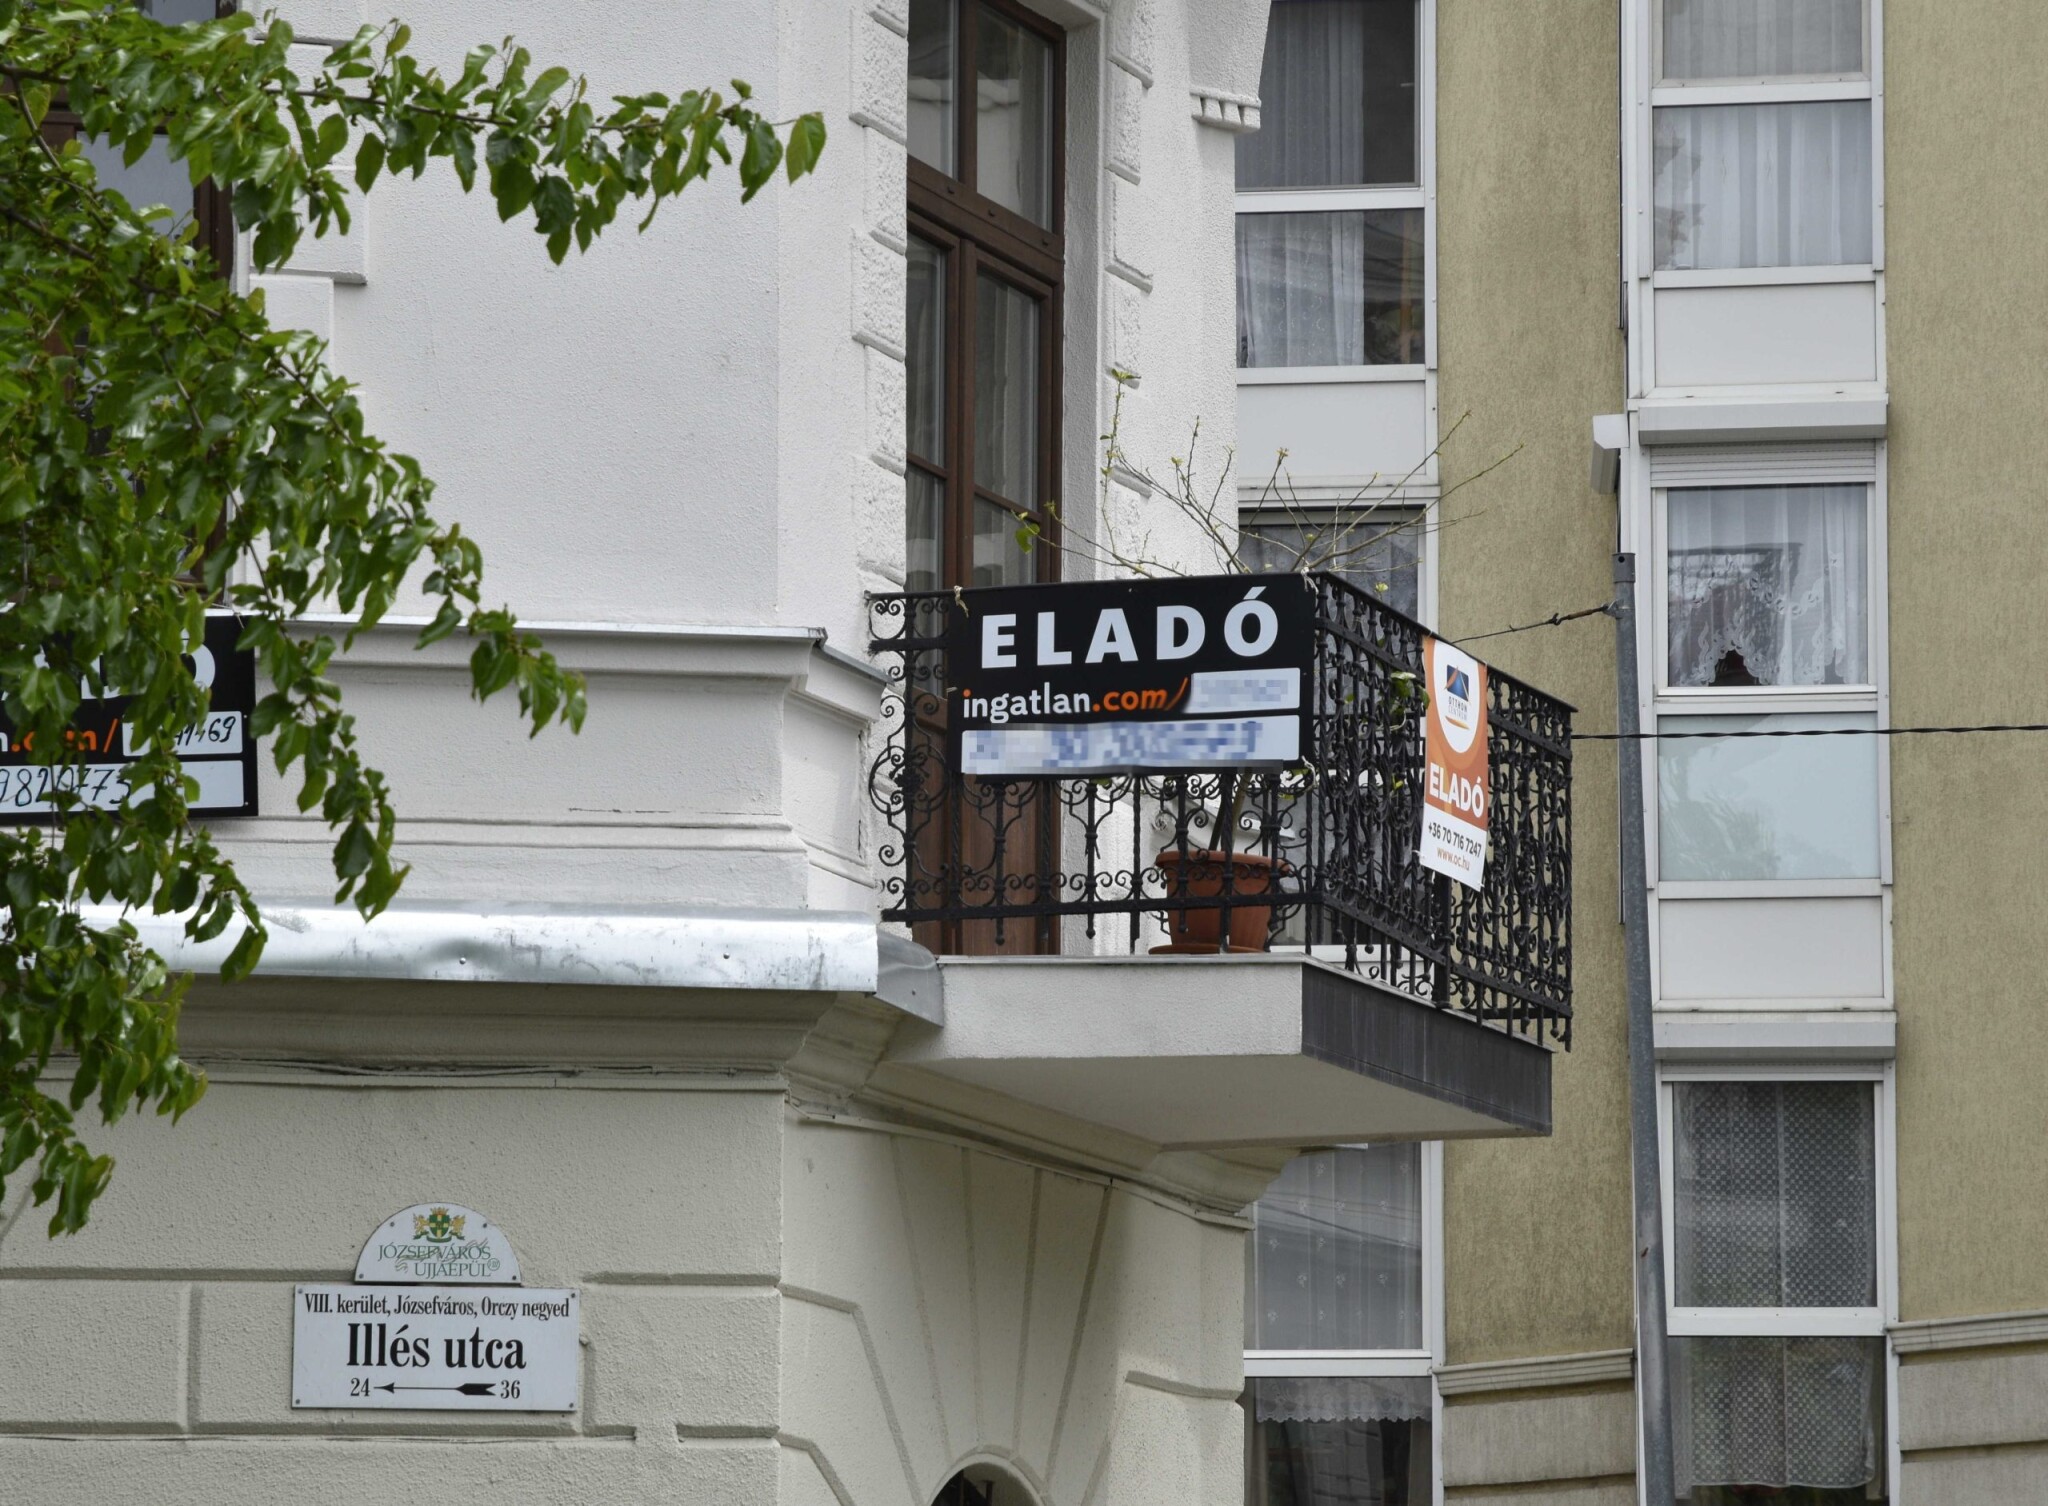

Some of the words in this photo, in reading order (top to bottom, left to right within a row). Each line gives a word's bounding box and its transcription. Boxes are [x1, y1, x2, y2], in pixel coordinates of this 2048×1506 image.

[981, 586, 1279, 669] ELADÓ
[1429, 762, 1485, 818] ELADÓ
[1428, 822, 1441, 840] +36
[1443, 827, 1452, 844] 70
[1453, 832, 1464, 851] 716
[1466, 838, 1482, 858] 7247
[378, 1242, 492, 1261] JÓZSEFVÁROS
[304, 1293, 333, 1314] VIII.
[336, 1294, 391, 1317] kerület,
[393, 1295, 479, 1318] Józsefváros,
[481, 1296, 519, 1320] Orczy
[521, 1298, 570, 1321] negyed
[346, 1323, 431, 1368] Illés
[444, 1326, 527, 1370] utca
[350, 1377, 370, 1397] 24
[500, 1380, 521, 1399] 36
